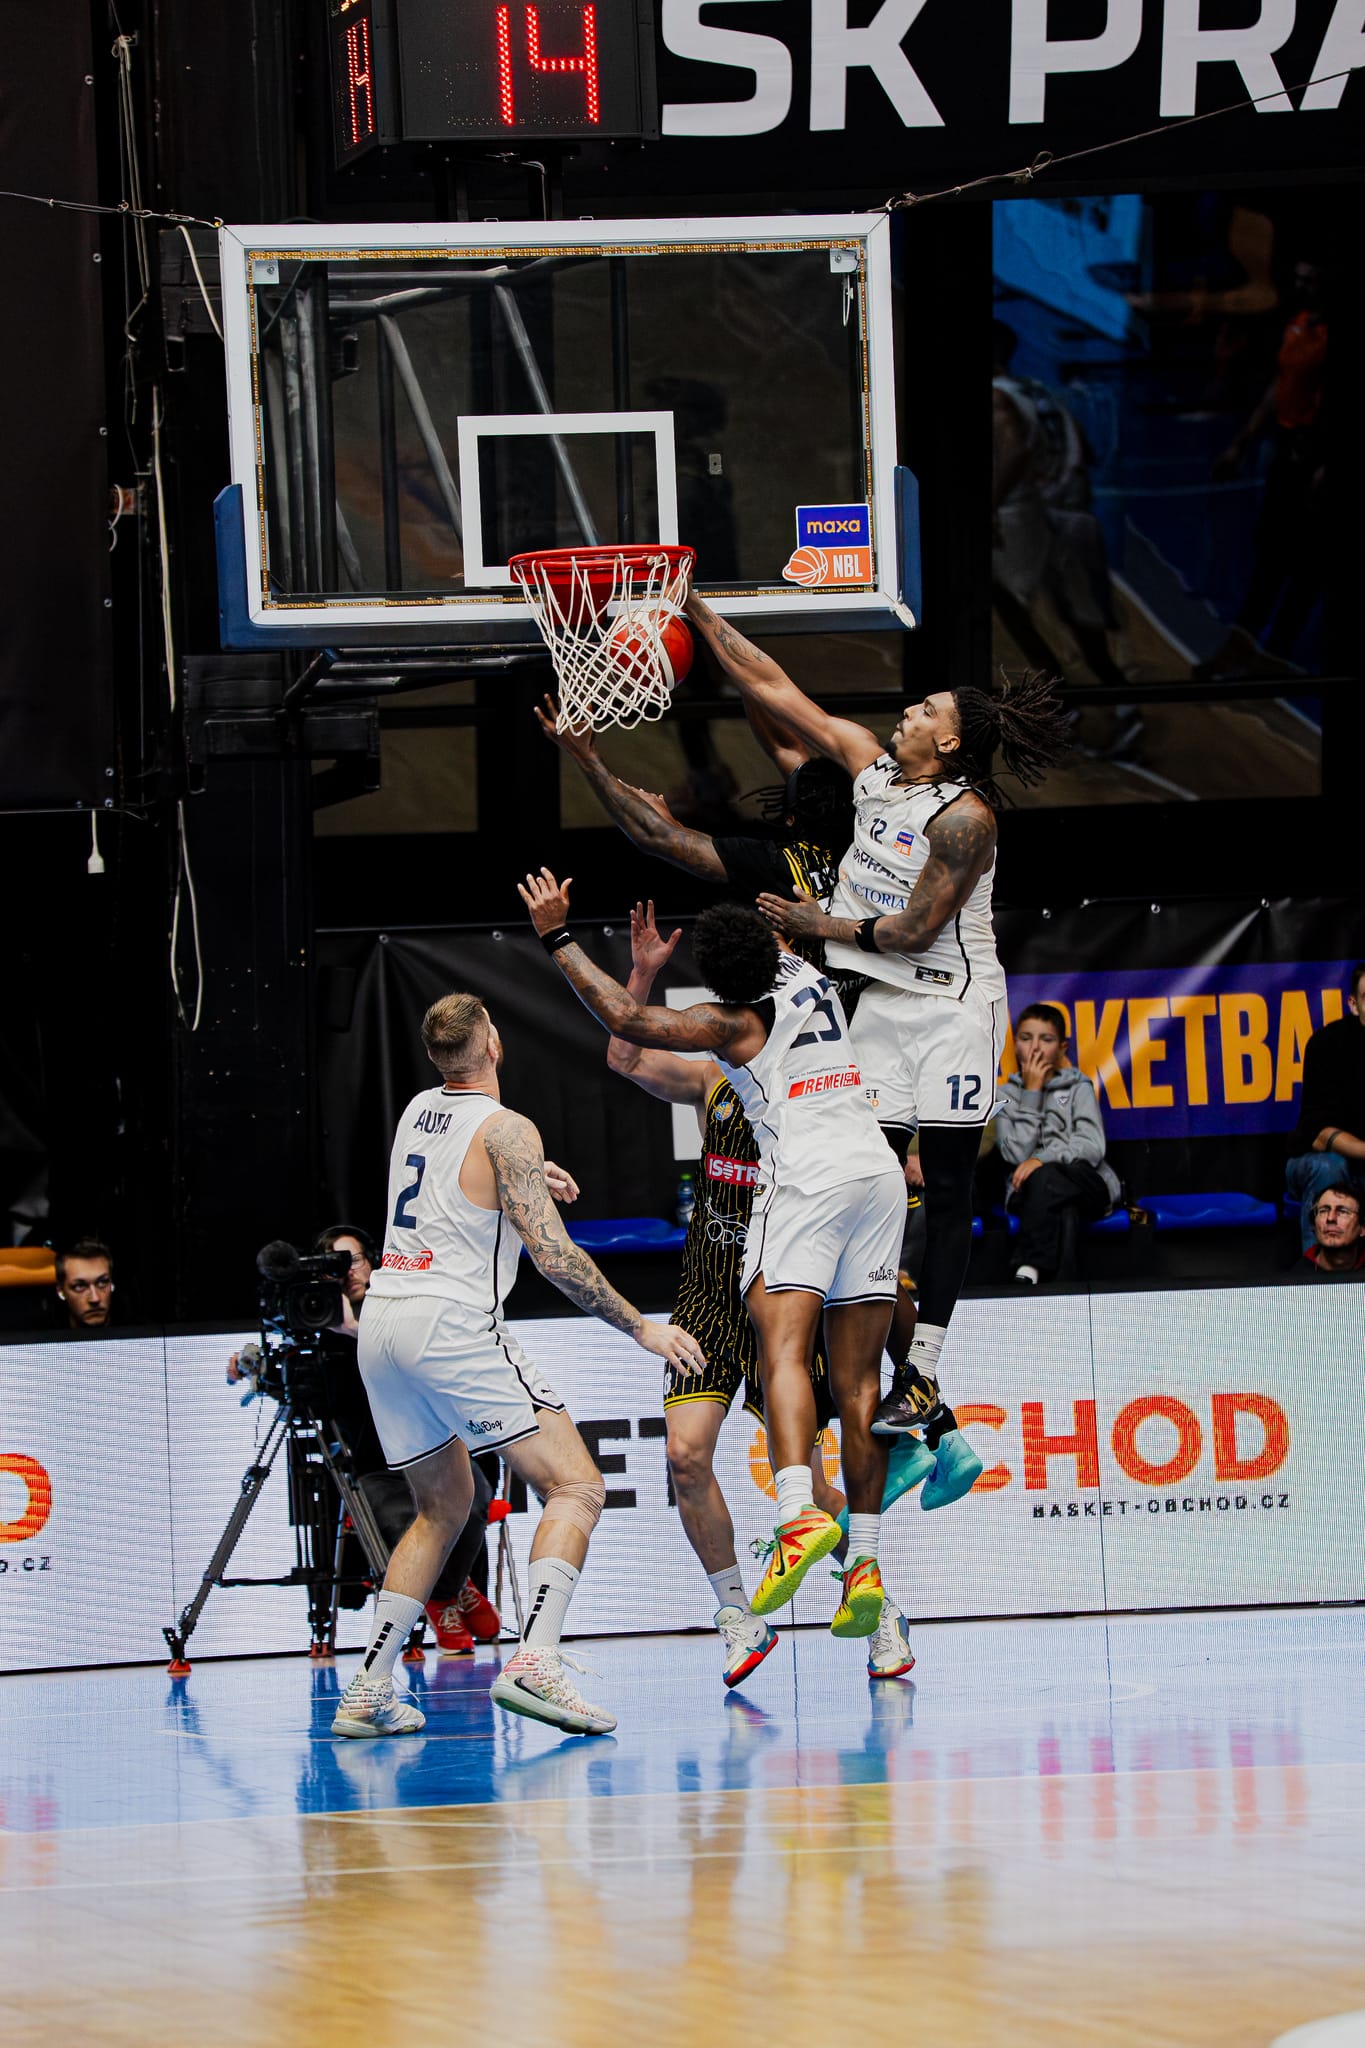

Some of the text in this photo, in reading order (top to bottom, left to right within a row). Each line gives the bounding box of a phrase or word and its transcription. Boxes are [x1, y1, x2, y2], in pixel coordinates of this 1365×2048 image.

[495, 4, 600, 127] 14
[806, 519, 861, 535] maxa
[833, 553, 864, 578] NBL
[869, 818, 888, 845] 12
[946, 1074, 982, 1111] 12
[392, 1153, 426, 1230] 2
